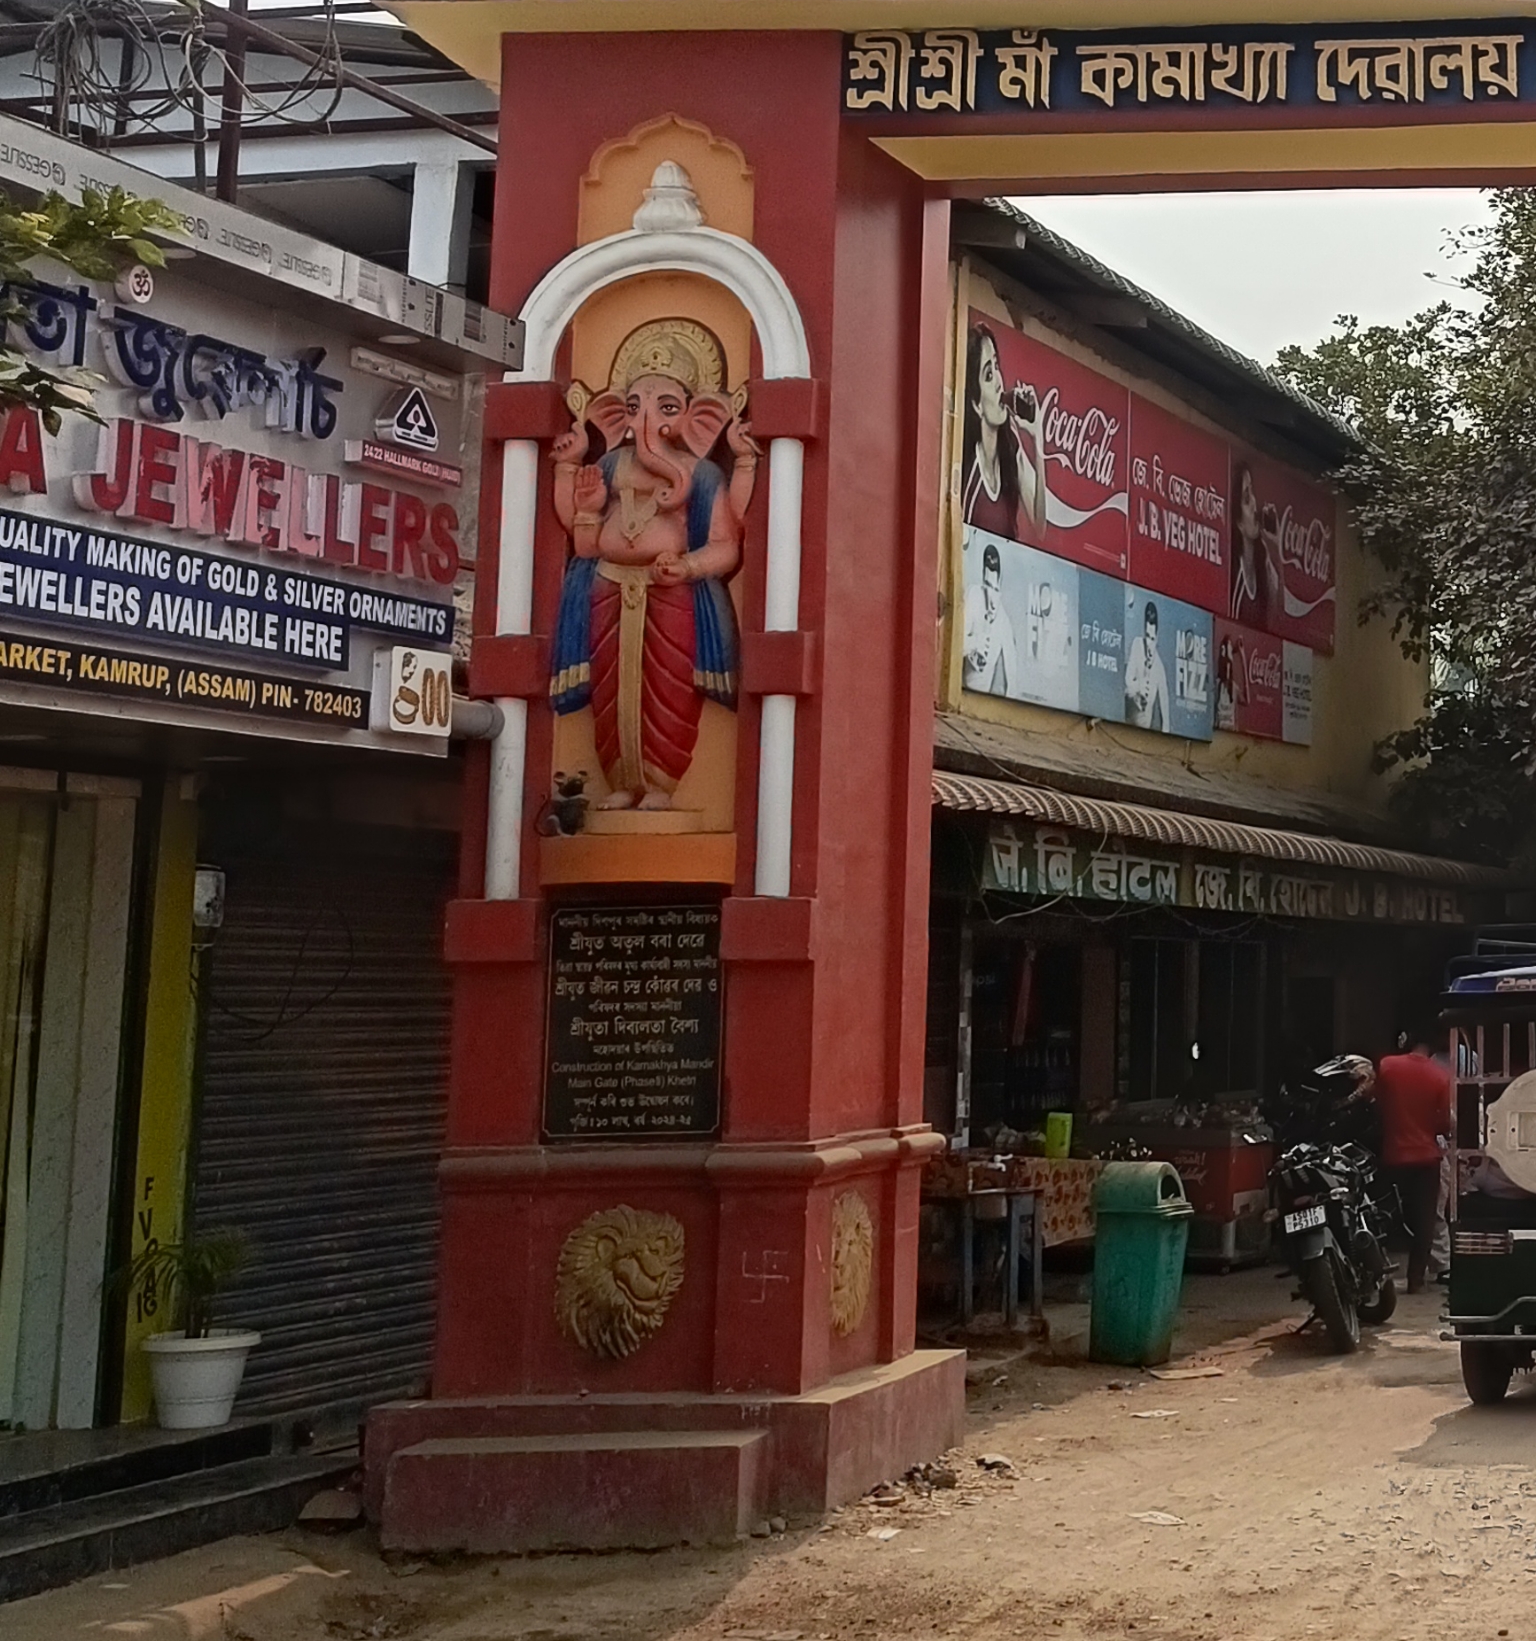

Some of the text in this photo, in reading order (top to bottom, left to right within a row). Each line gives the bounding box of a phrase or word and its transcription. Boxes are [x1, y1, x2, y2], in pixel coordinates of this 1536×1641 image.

[1076, 43, 1294, 107] কামাখ্যা
[88, 417, 460, 585] JEWELLERS
[1163, 509, 1186, 551] VEG
[1187, 520, 1222, 565] HOTEL
[86, 535, 171, 580] MAKING
[177, 555, 204, 585] OF
[208, 561, 259, 597] GOLD
[265, 573, 277, 601] &
[284, 578, 345, 615] SILVER
[350, 591, 446, 636] ORNAMENTS
[146, 592, 279, 650] AVAILABLE
[285, 617, 343, 662] HERE
[1176, 629, 1207, 663] MORE
[79, 654, 171, 696] KAMRUP,
[177, 669, 256, 708] (ASSAM)
[305, 689, 361, 718] 782403
[551, 1059, 714, 1073] Construction of Kamakhya Mandir
[568, 1075, 696, 1088] Main Gate Khetri
